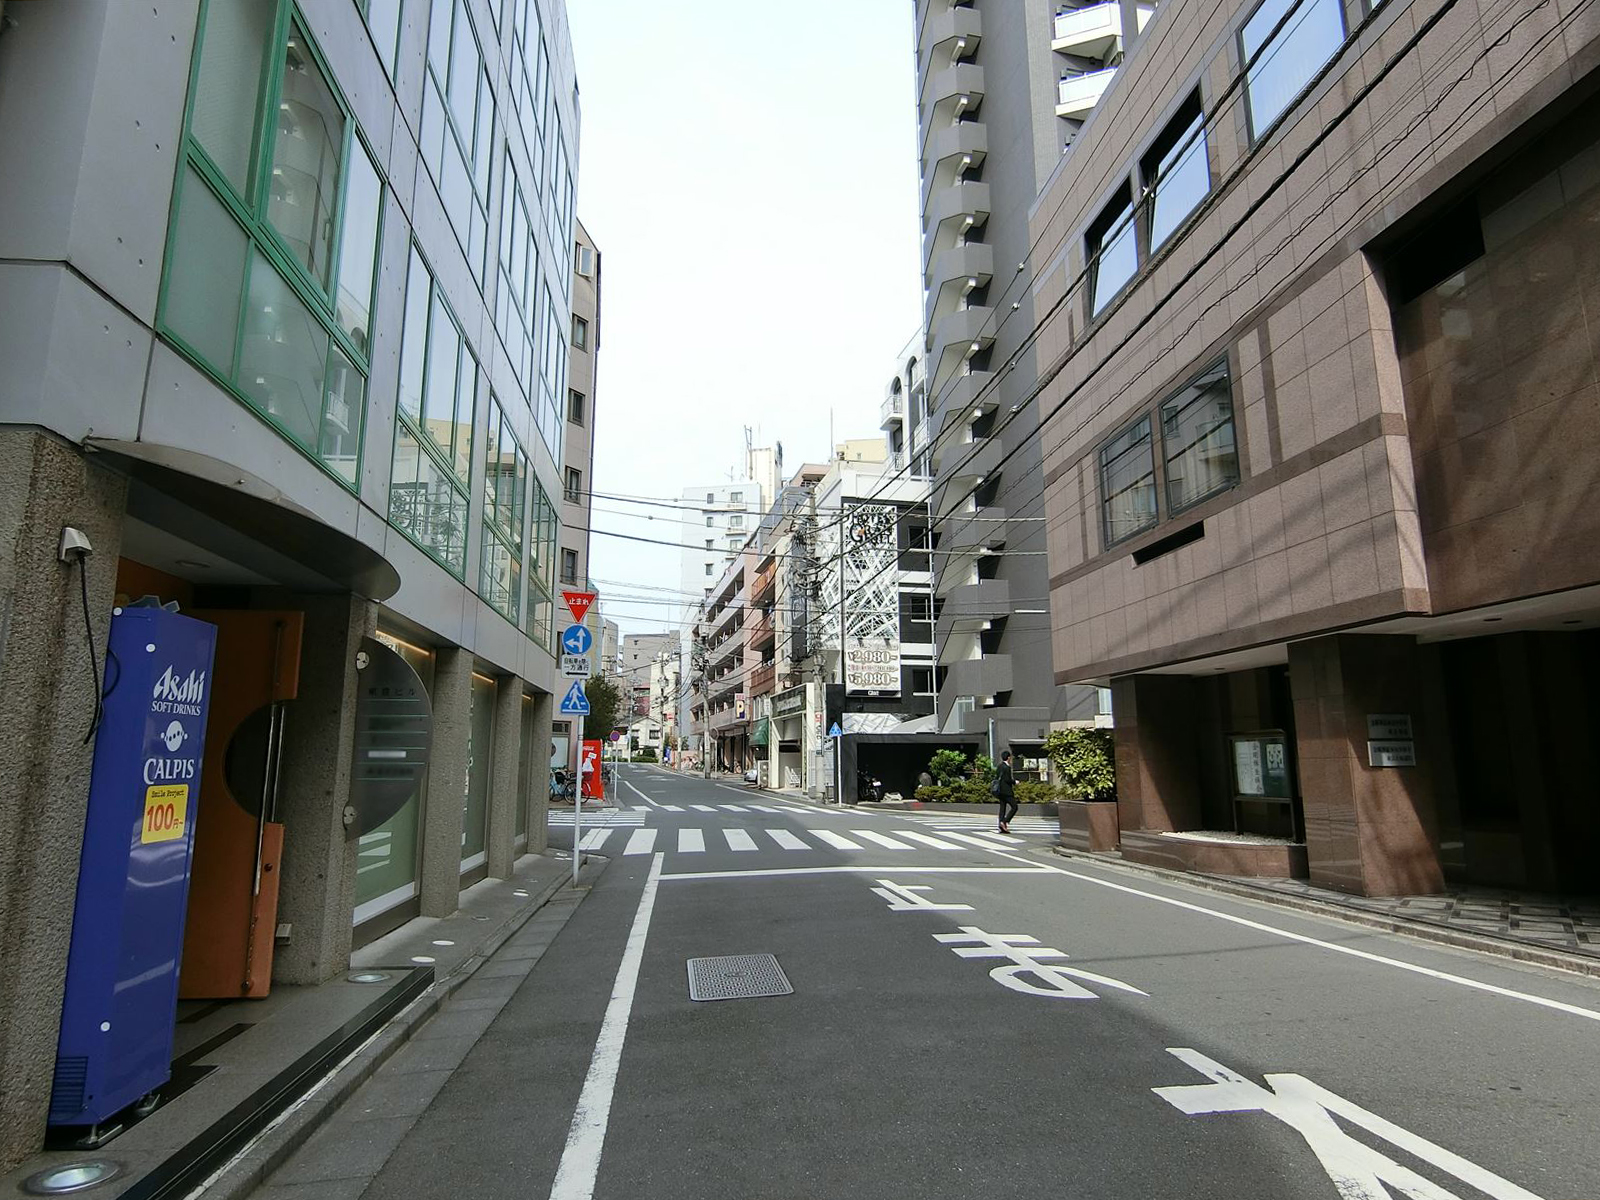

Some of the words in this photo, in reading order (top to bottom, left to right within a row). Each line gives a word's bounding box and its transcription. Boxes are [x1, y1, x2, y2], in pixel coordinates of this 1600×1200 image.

[154, 664, 205, 703] Asahi
[151, 701, 173, 713] SOFT
[173, 702, 201, 716] DRINKS
[143, 757, 195, 785] CALPIS
[151, 789, 166, 799] Smile
[167, 788, 185, 798] Project
